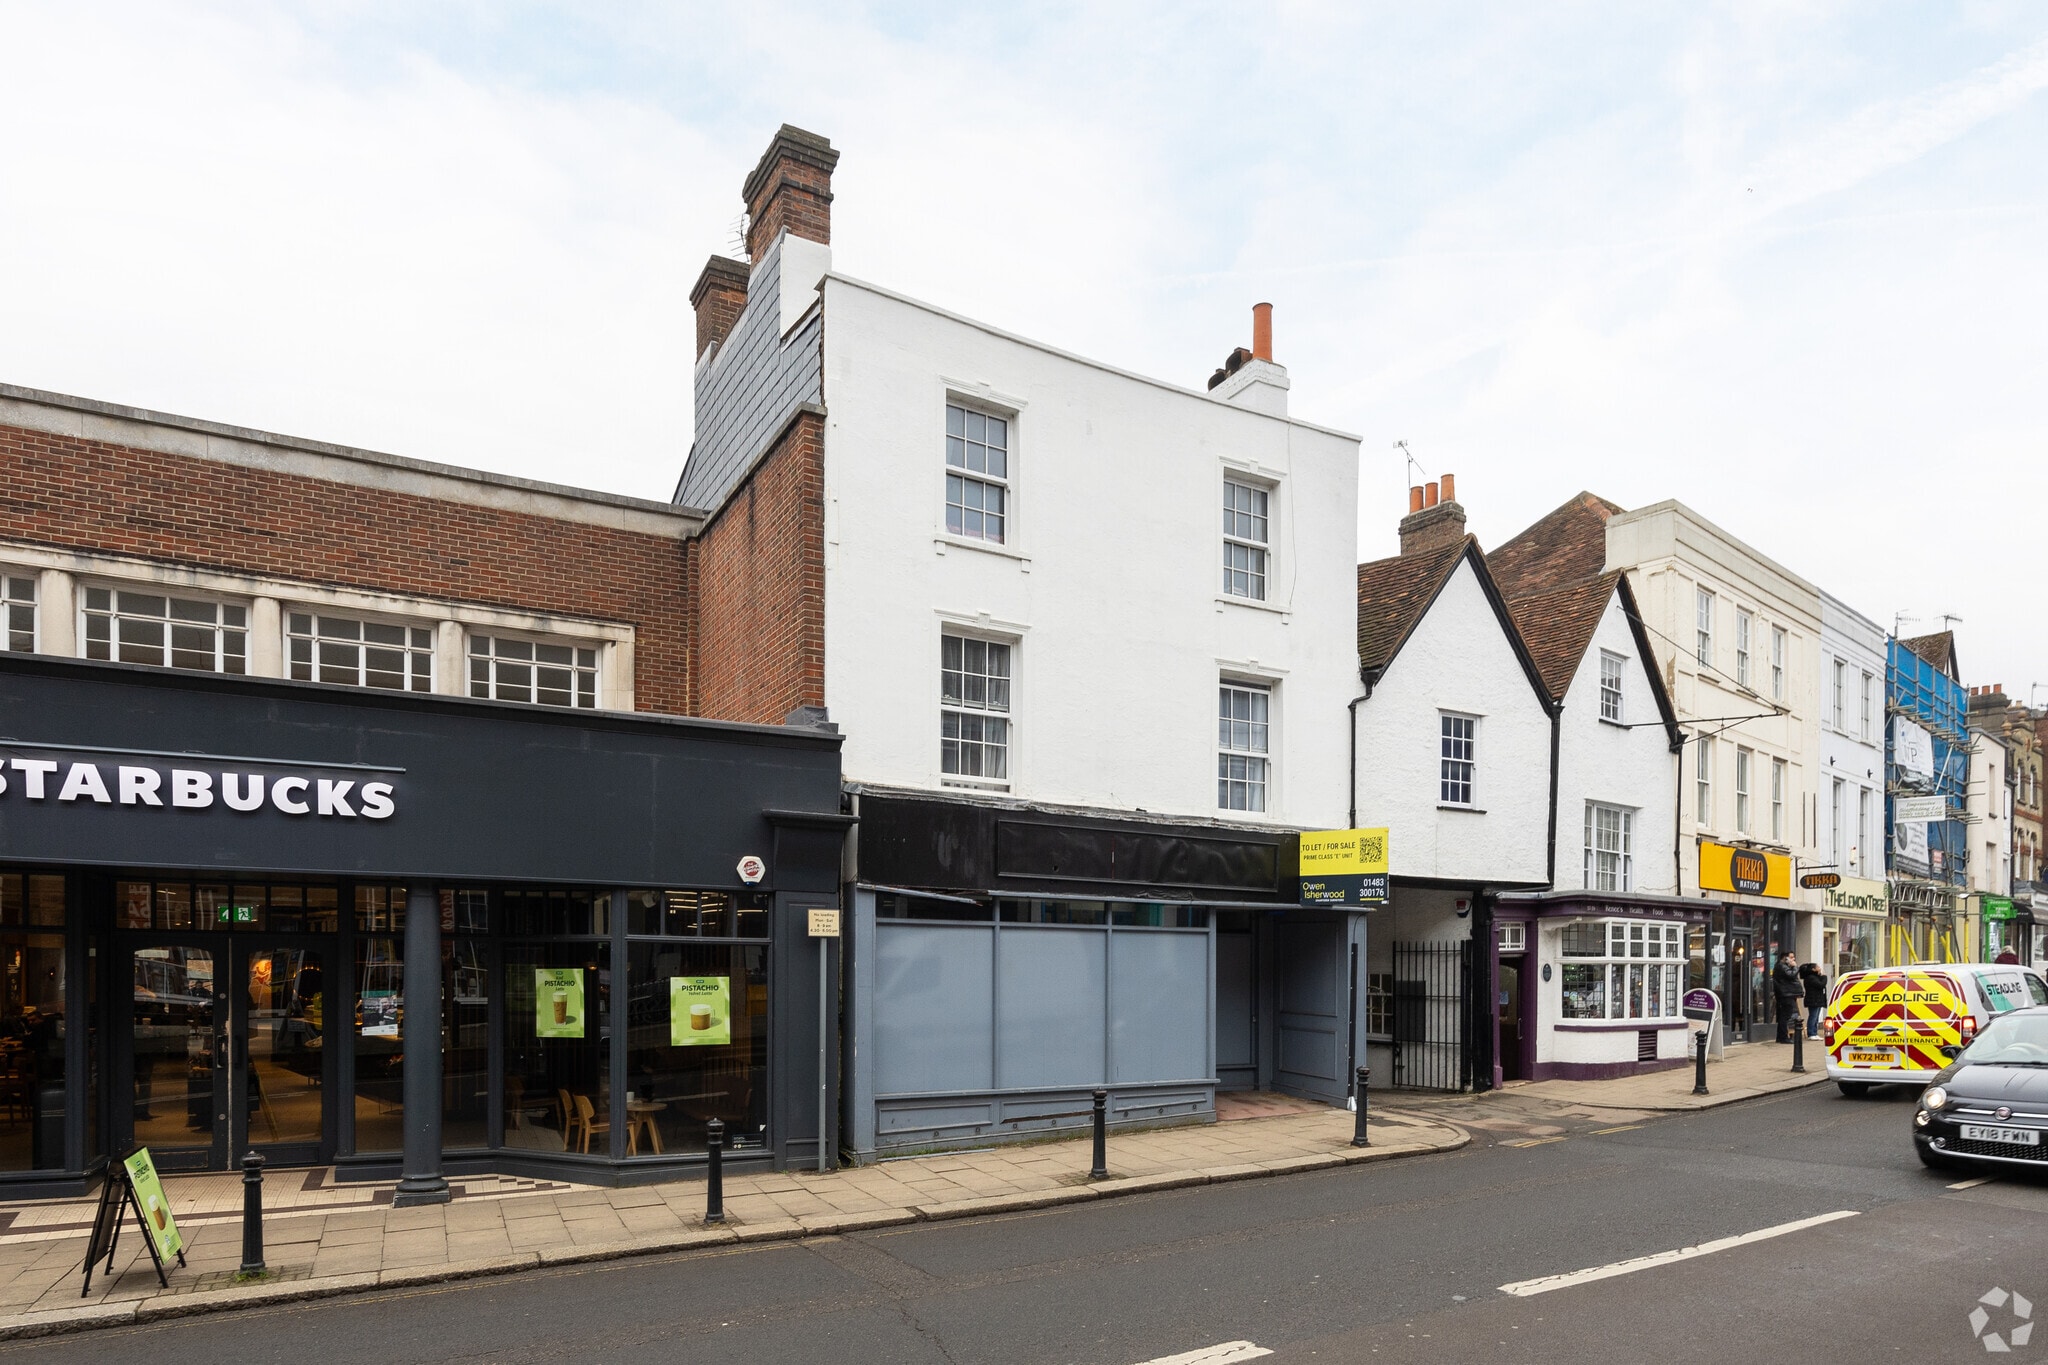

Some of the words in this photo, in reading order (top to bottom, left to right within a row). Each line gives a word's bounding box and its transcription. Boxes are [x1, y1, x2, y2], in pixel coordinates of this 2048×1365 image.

[0, 758, 395, 819] TARBUCKS
[1311, 843, 1322, 851] LET
[1327, 842, 1339, 850] FOR
[1340, 841, 1356, 849] SALE
[1736, 856, 1764, 882] TIKKA
[1363, 878, 1385, 887] 01483
[1804, 874, 1838, 885] TIKKA
[1302, 882, 1325, 890] Owen
[1740, 880, 1760, 890] NATION
[1304, 889, 1345, 899] Isherwood
[1360, 888, 1385, 897] 300176
[1629, 906, 1644, 915] Health
[1652, 908, 1664, 916] Food
[1672, 910, 1684, 918] Shop
[1986, 982, 2022, 996] STEADLINE
[1851, 992, 1939, 1003] STEADLINE
[1850, 1036, 1883, 1044] HIGHWAY
[1885, 1036, 1941, 1044] MAINTENANCE
[1851, 1053, 1873, 1062] VK72
[1874, 1053, 1891, 1062] HZT
[1968, 1127, 1999, 1140] EY18
[2002, 1130, 2030, 1142] FWN
